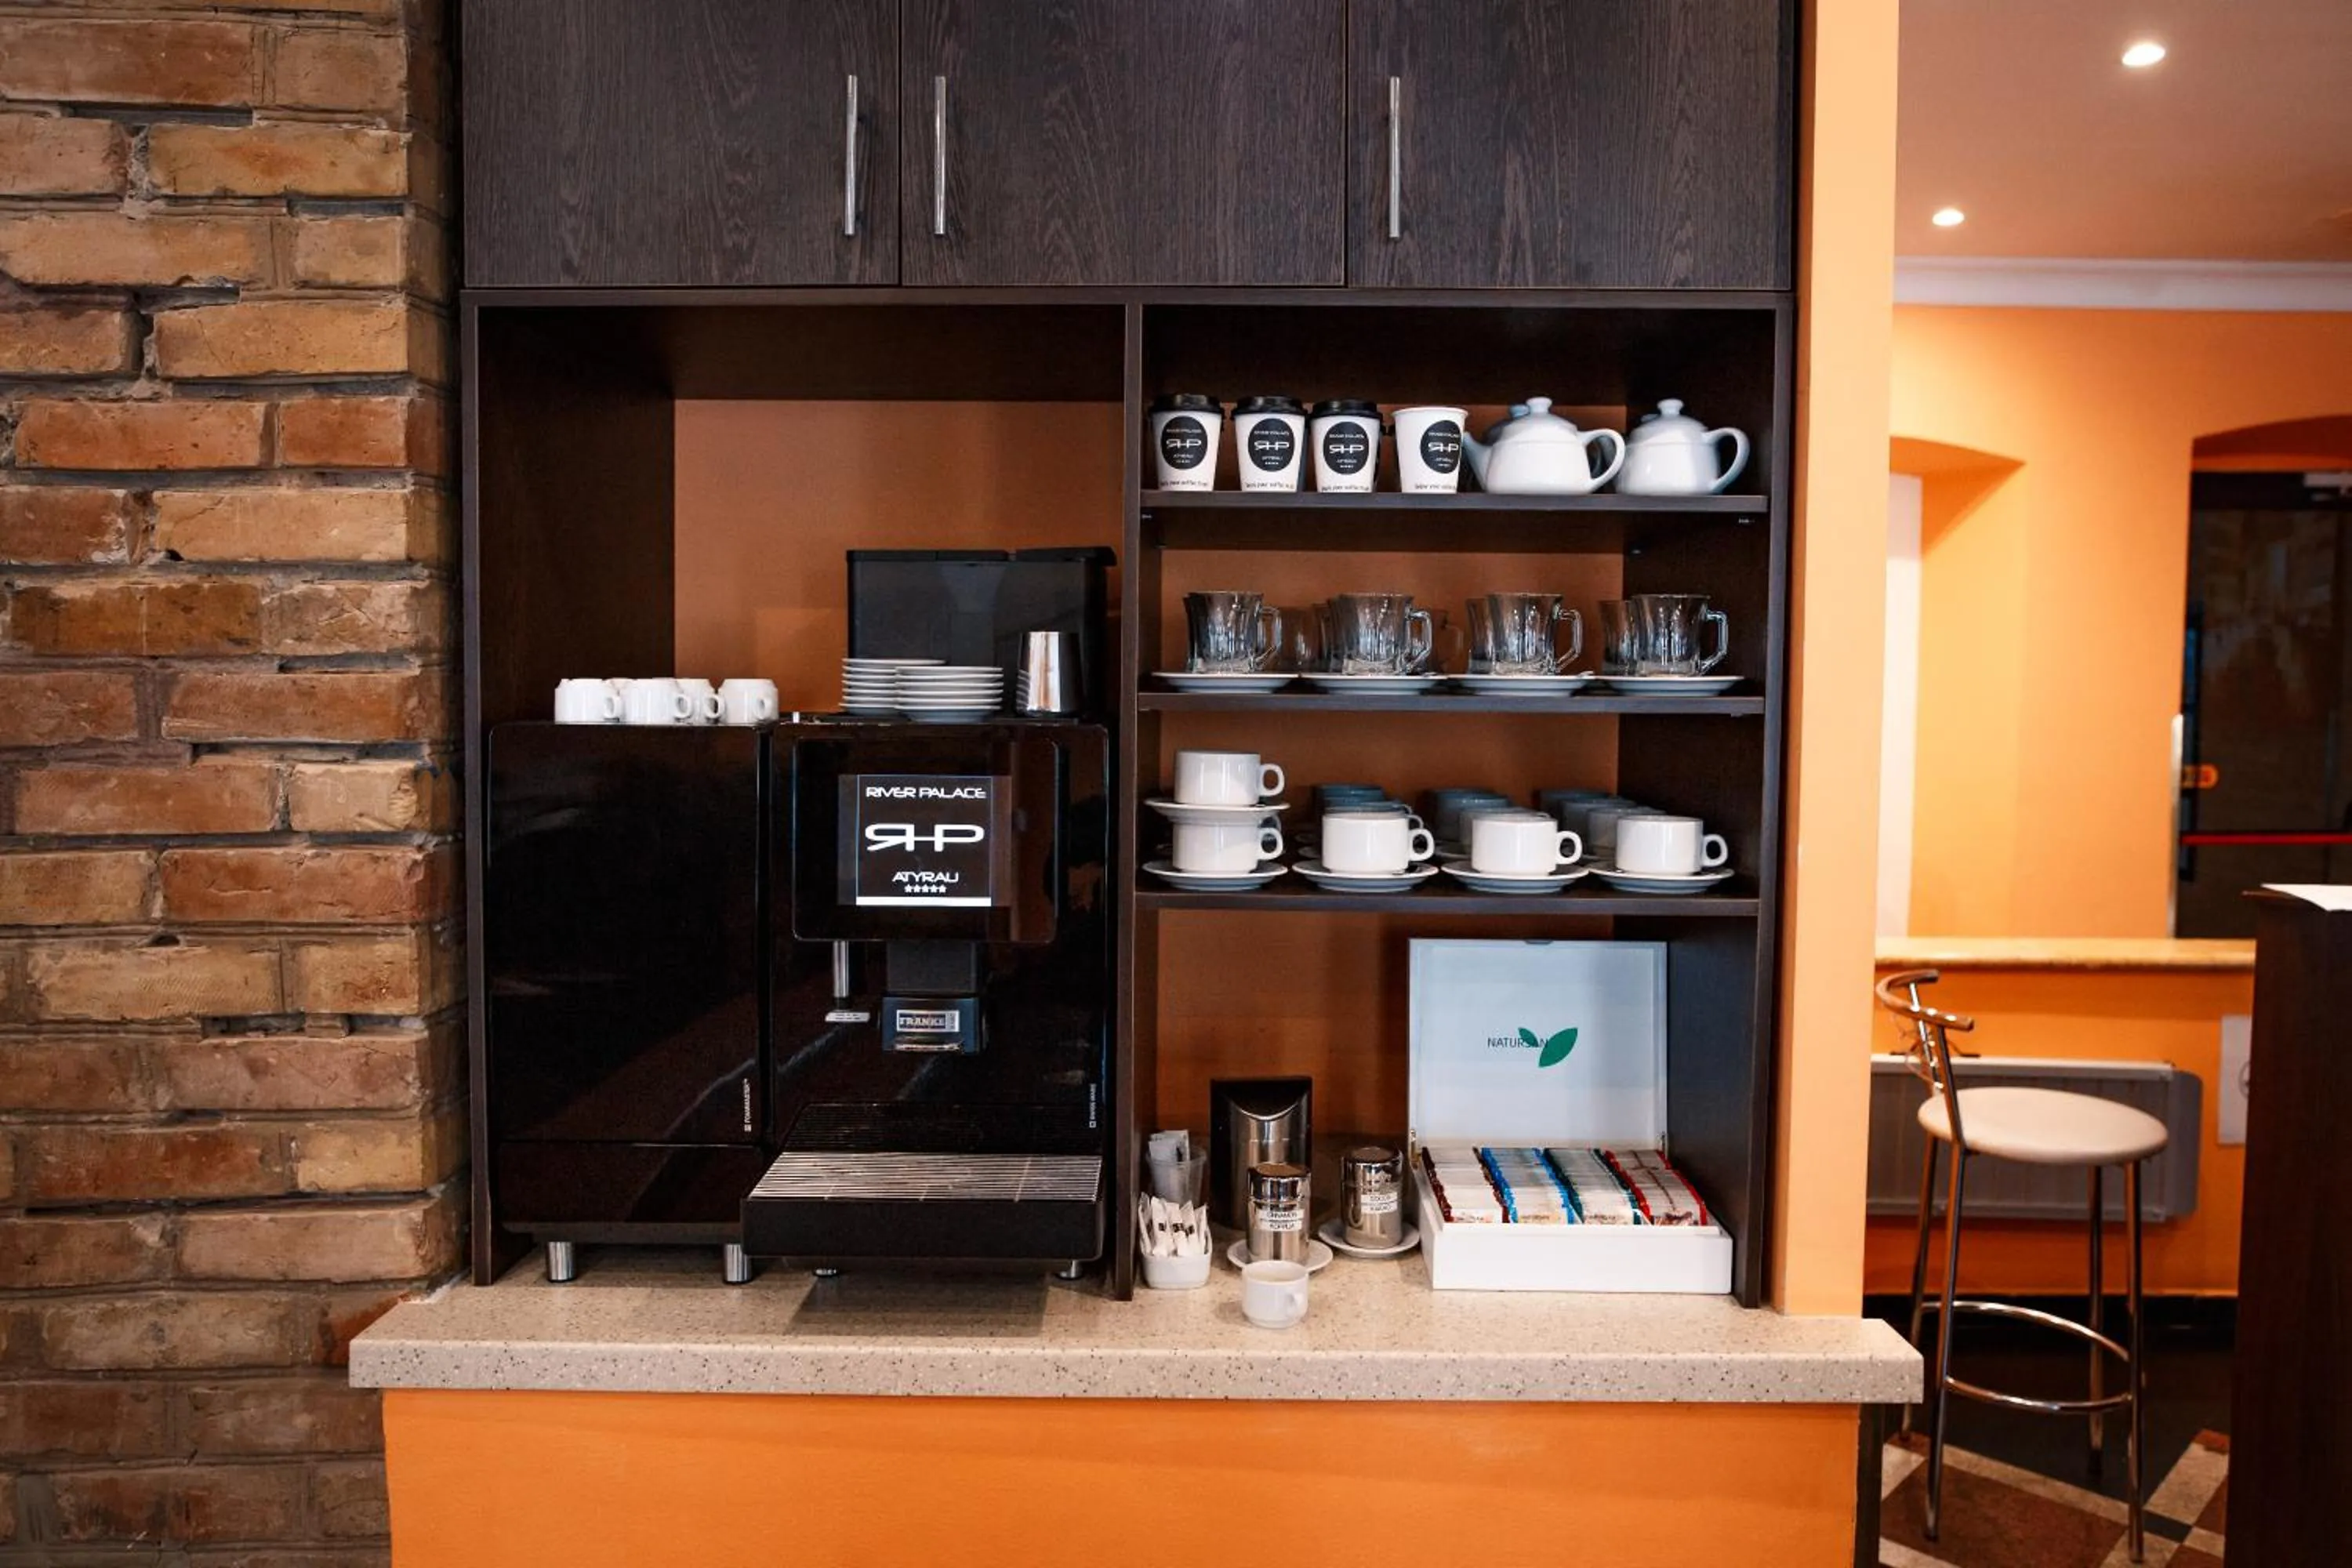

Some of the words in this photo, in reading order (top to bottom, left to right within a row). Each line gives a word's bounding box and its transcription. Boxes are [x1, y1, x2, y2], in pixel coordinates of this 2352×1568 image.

[866, 786, 916, 798] RIVER
[919, 787, 986, 799] PALACE
[892, 872, 959, 884] ATYRAU
[899, 1017, 945, 1026] FRANKE
[1487, 1036, 1548, 1048] NATURN
